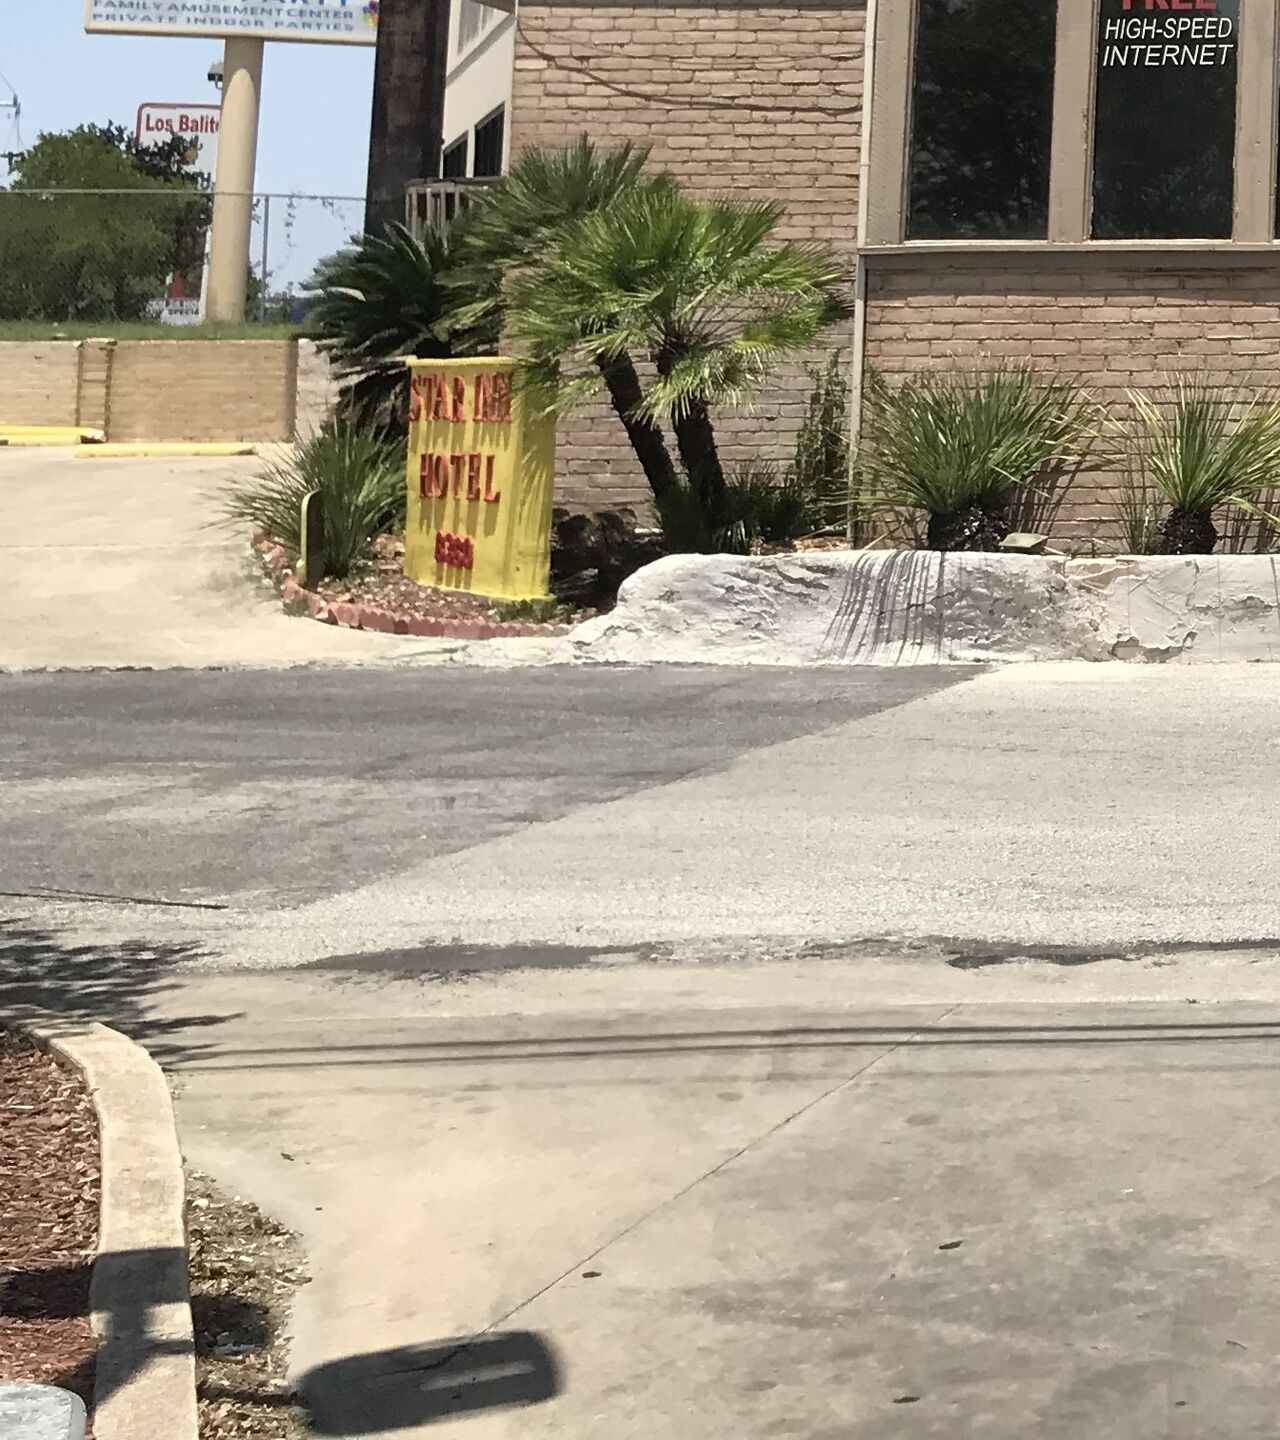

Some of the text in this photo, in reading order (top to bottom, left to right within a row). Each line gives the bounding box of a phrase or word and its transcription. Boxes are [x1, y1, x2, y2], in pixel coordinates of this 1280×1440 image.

[1104, 17, 1233, 40] HIGH-SPEED
[1103, 44, 1234, 66] INTERNET
[146, 114, 172, 132] Los
[409, 374, 466, 422] STAR
[420, 452, 501, 503] HOTEL
